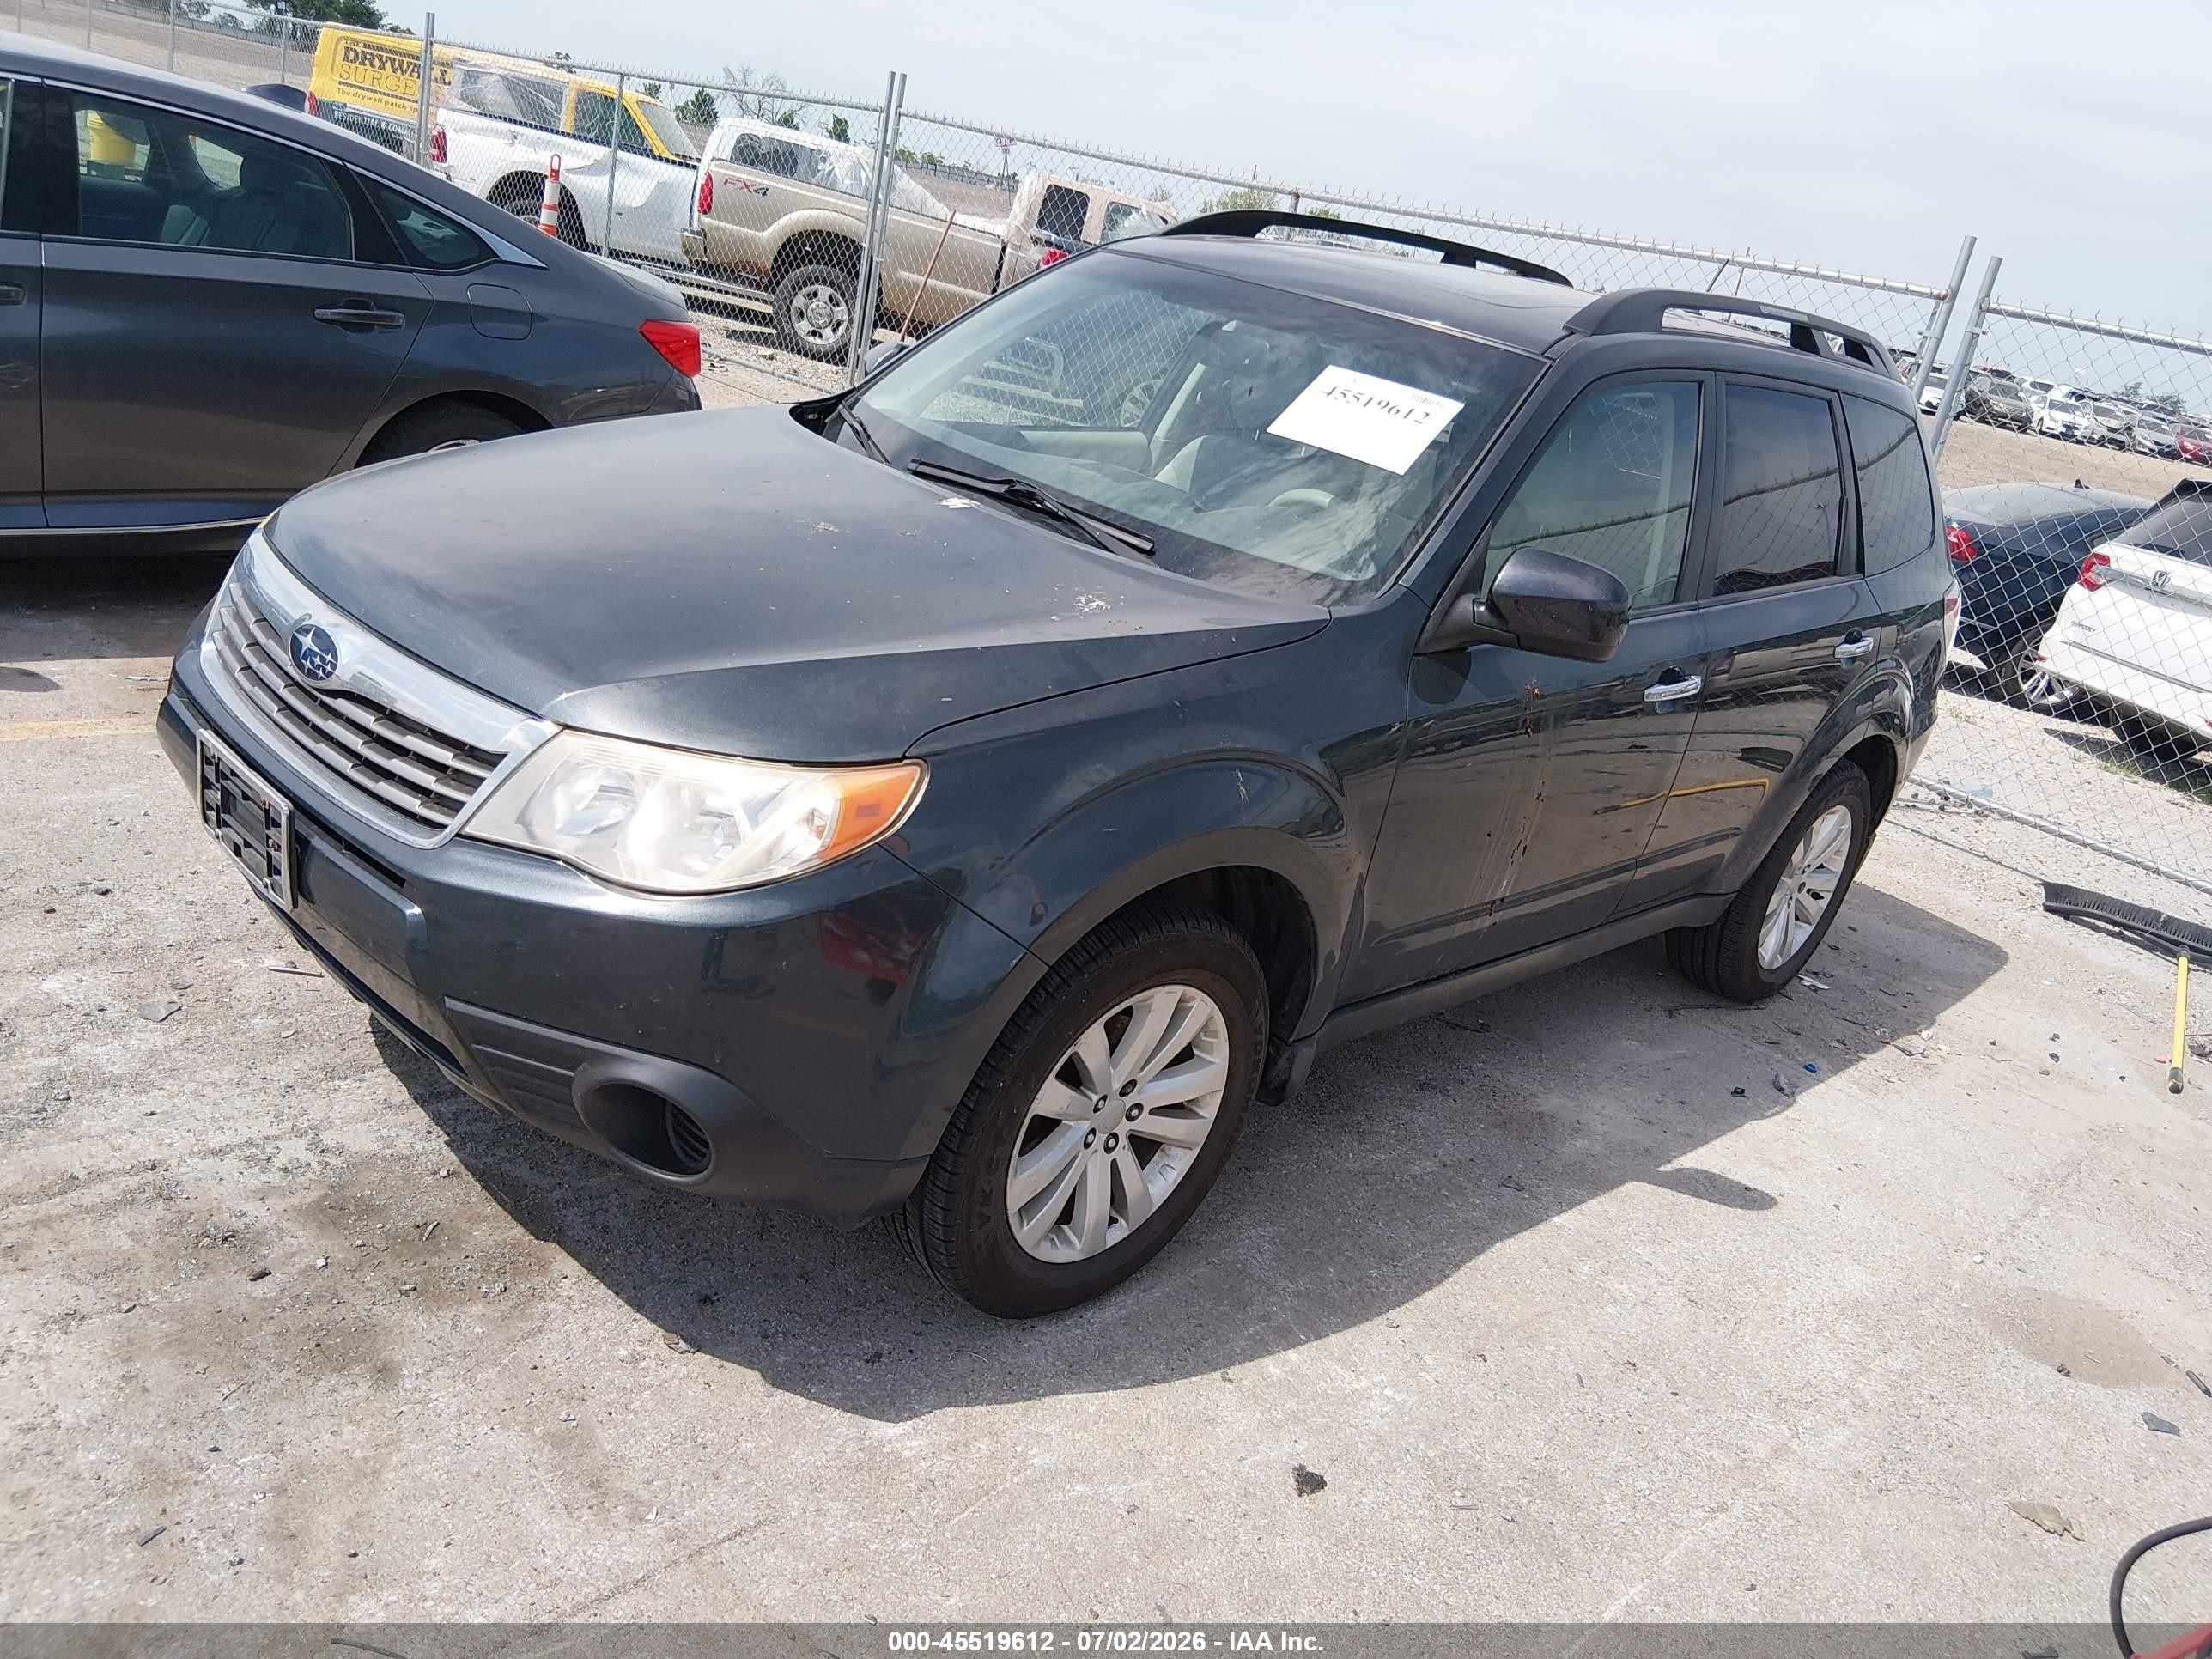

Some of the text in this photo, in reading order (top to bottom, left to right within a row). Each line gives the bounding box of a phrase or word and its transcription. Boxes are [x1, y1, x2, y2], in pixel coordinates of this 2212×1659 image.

[343, 46, 451, 86] DRYWAL
[337, 88, 350, 96] The
[352, 90, 383, 104] drywall
[385, 100, 407, 112] patch
[723, 178, 769, 198] FX4
[1322, 386, 1430, 424] 45519612
